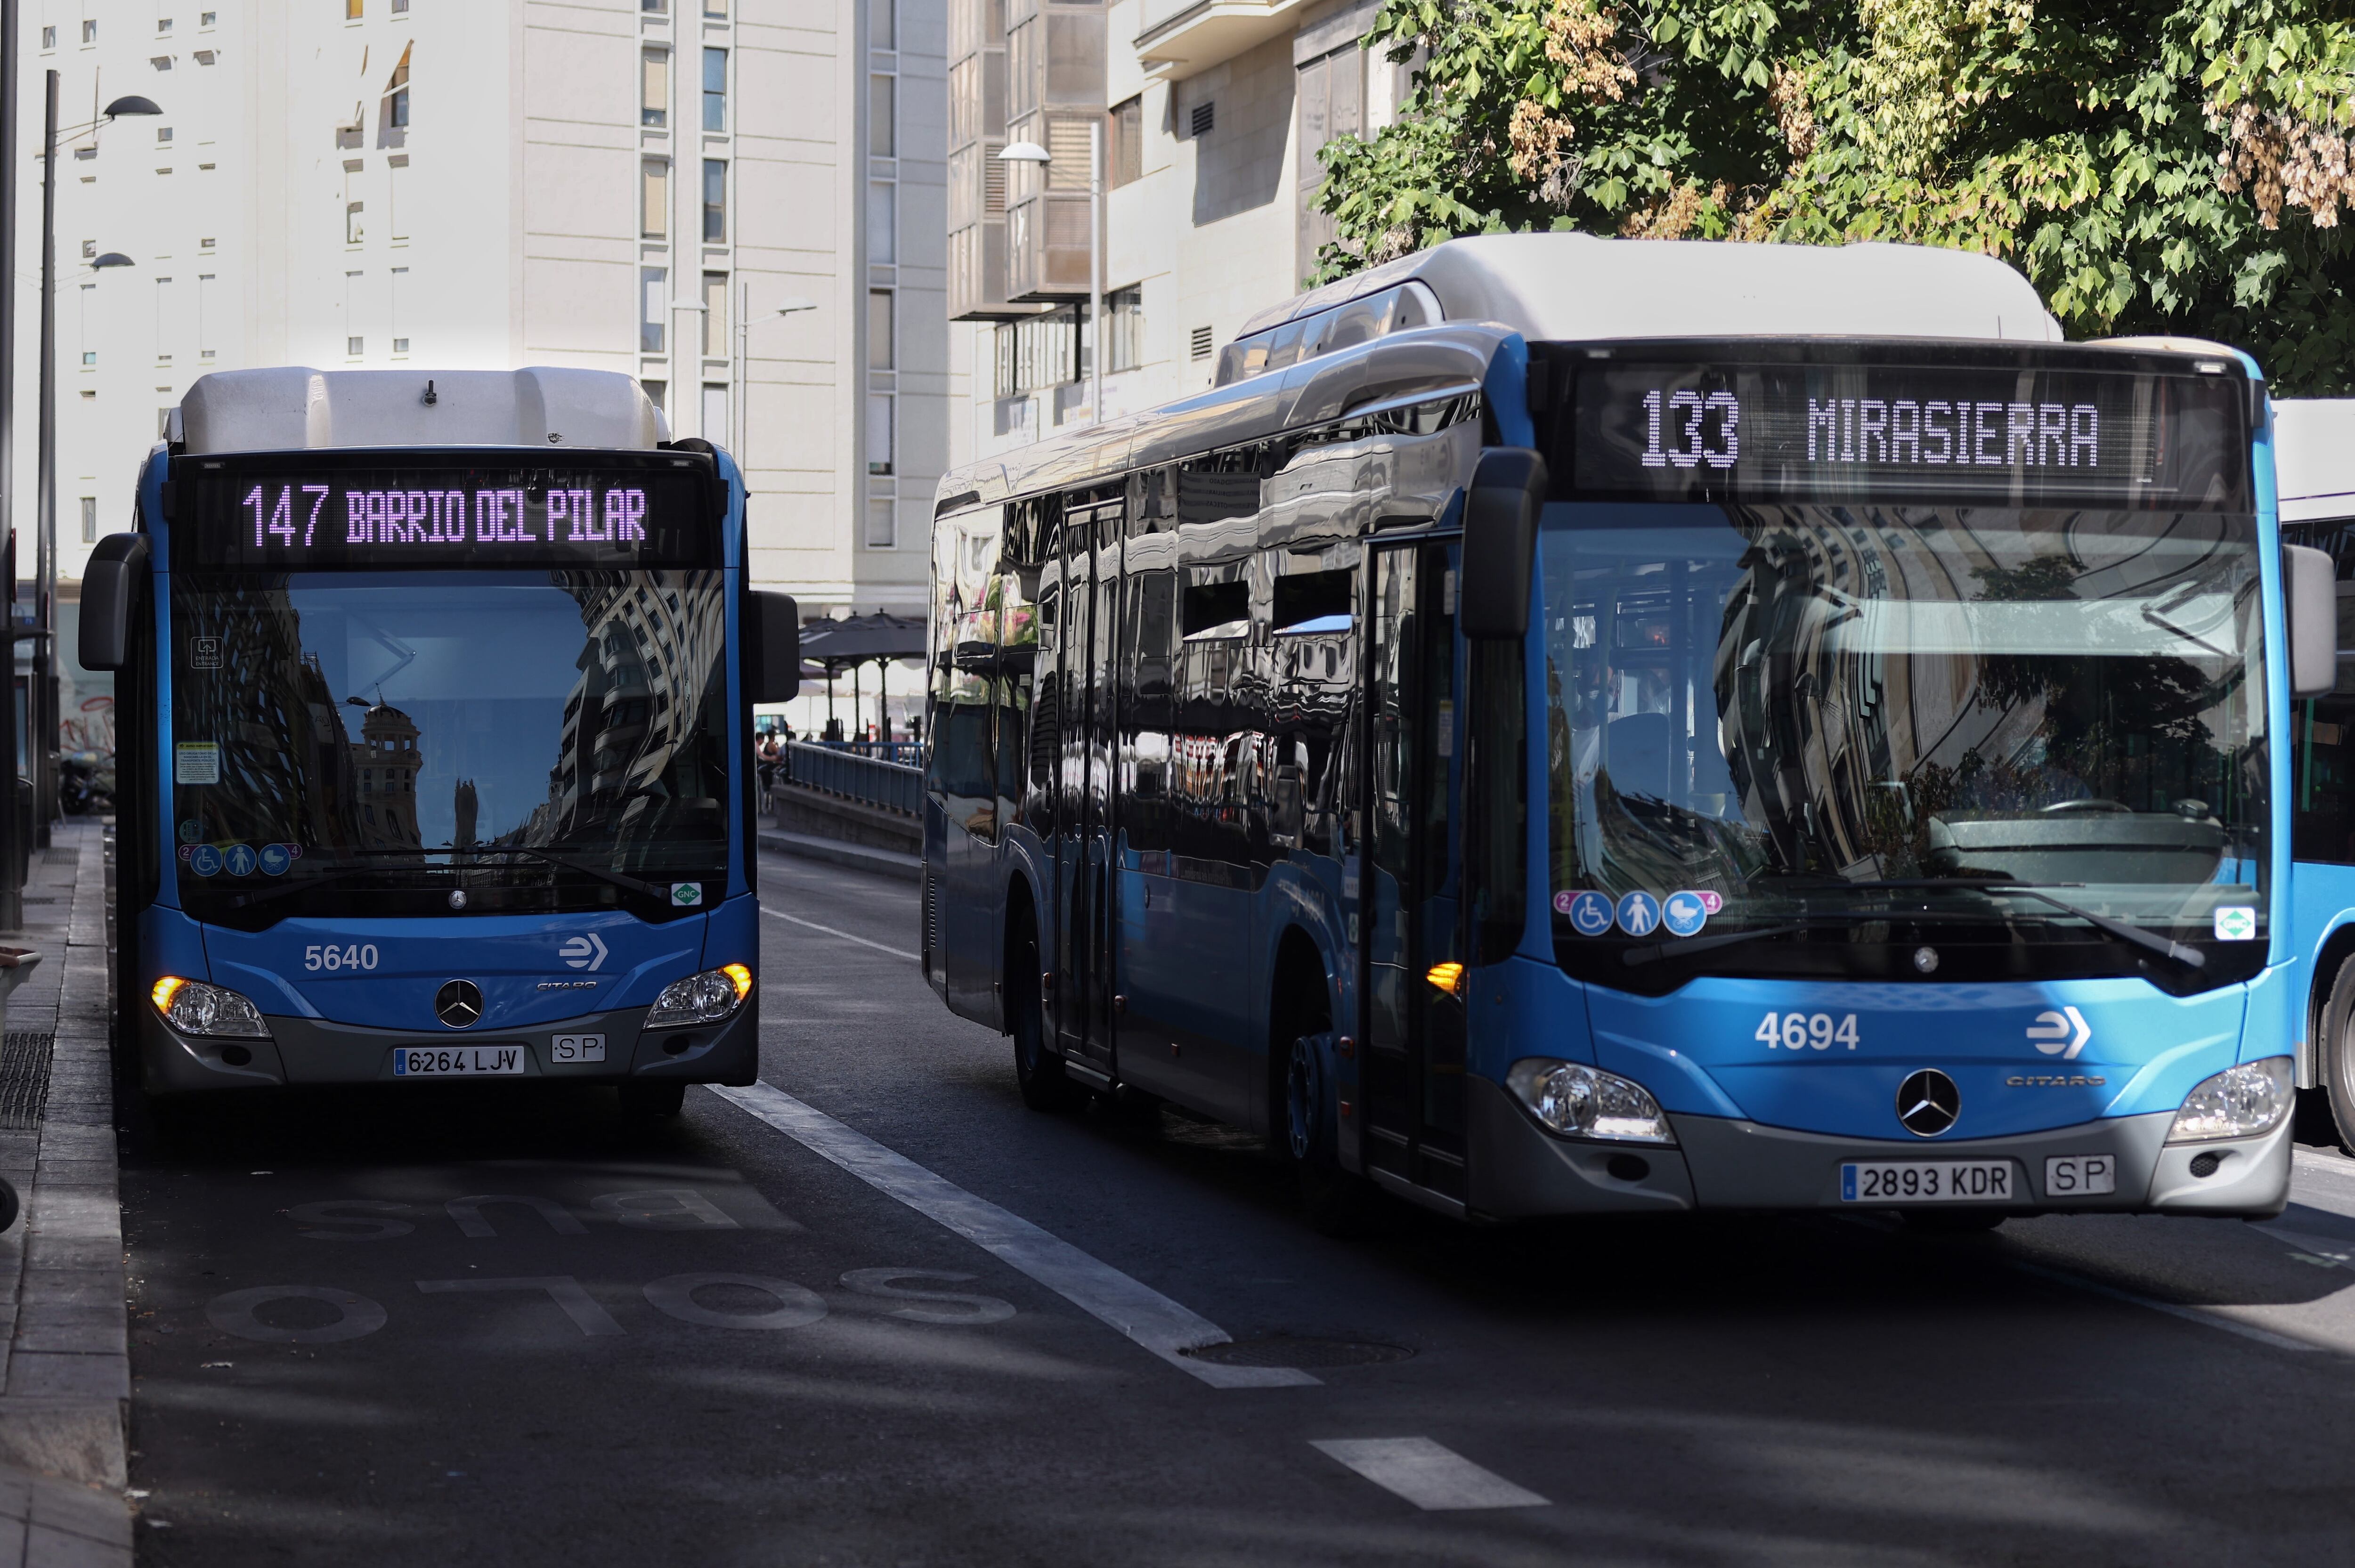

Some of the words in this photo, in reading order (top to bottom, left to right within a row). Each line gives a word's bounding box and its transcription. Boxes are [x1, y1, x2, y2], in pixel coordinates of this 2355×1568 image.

[1642, 390, 1738, 467] 133
[1808, 398, 2098, 466] MIRASIERRA
[243, 485, 329, 546] 147
[346, 491, 465, 543] BARRIO
[476, 490, 536, 542] DEL
[547, 489, 645, 541] PILAR
[183, 847, 189, 856] 2
[291, 845, 298, 854] 4
[1560, 895, 1569, 907] 2
[1707, 894, 1717, 908] 4
[304, 944, 378, 971] 5640
[536, 982, 597, 991] CITARO
[1754, 1012, 1860, 1050] 4694
[408, 1049, 466, 1072] 6264
[474, 1048, 517, 1072] LJV
[2006, 1075, 2107, 1087] CITARO
[1862, 1168, 1940, 1197] 2893
[1951, 1166, 2007, 1195] KDR
[204, 1266, 1017, 1345] SOLO
